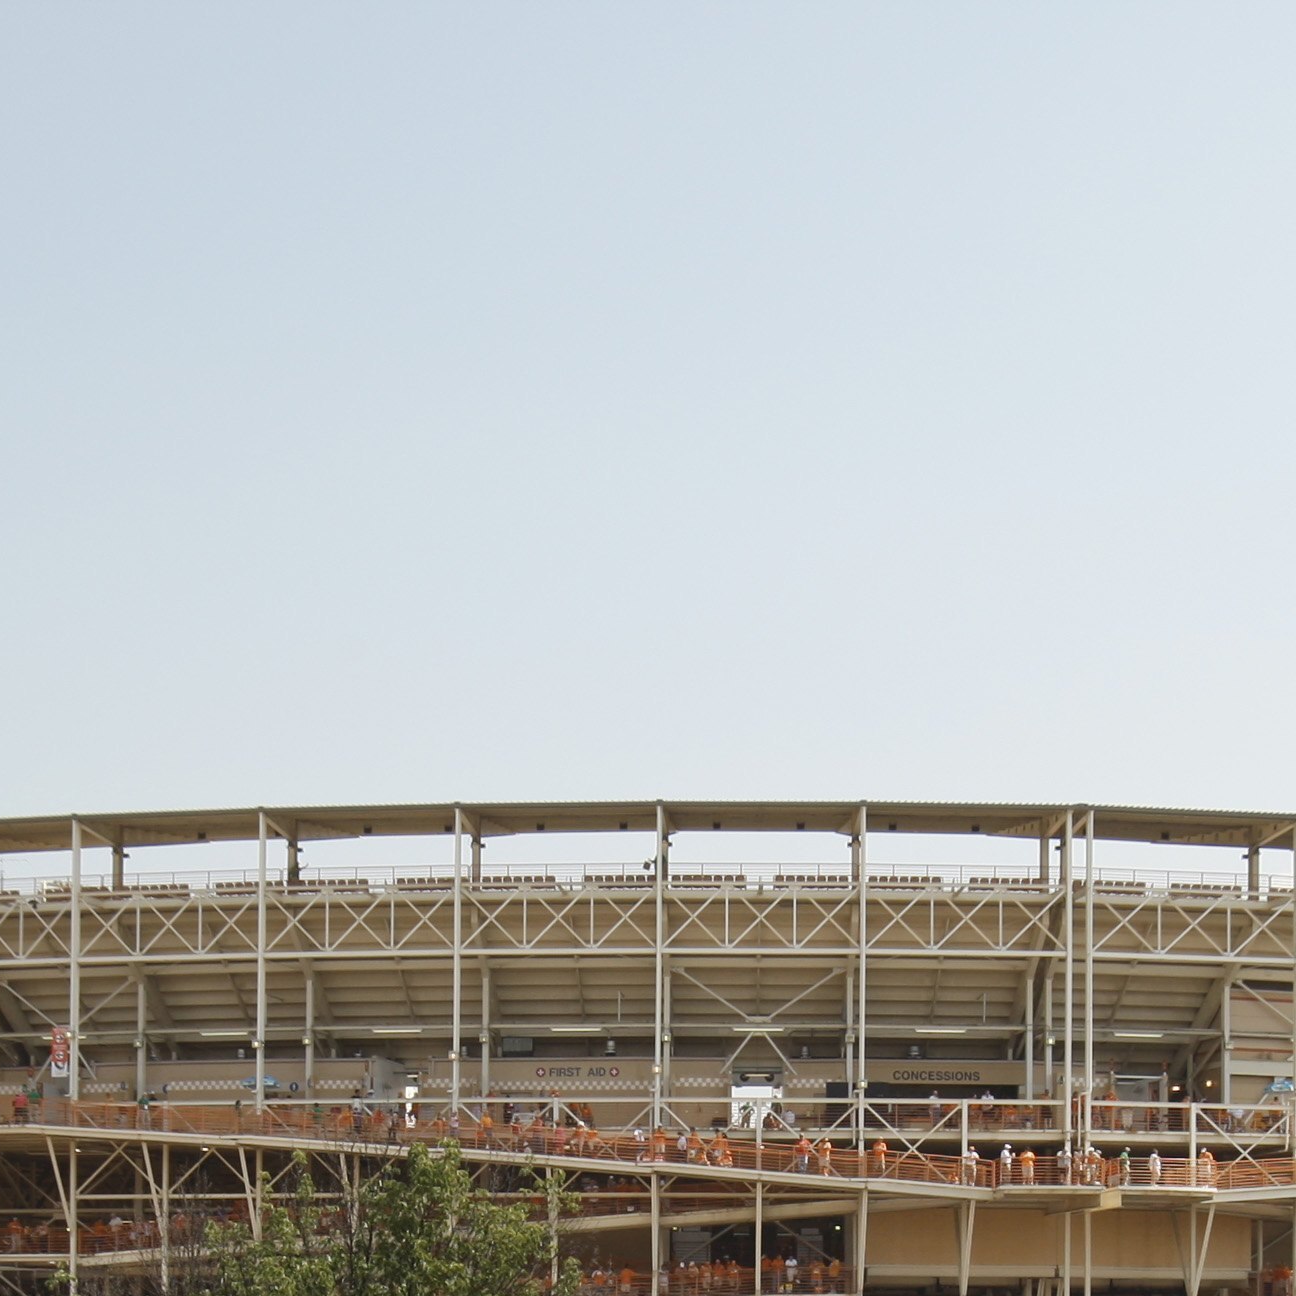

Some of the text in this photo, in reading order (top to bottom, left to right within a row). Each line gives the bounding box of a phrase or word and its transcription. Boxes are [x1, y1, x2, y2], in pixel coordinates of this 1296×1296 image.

[549, 1067, 606, 1077] FIRST AID
[892, 1070, 981, 1081] CONCESSIONS
